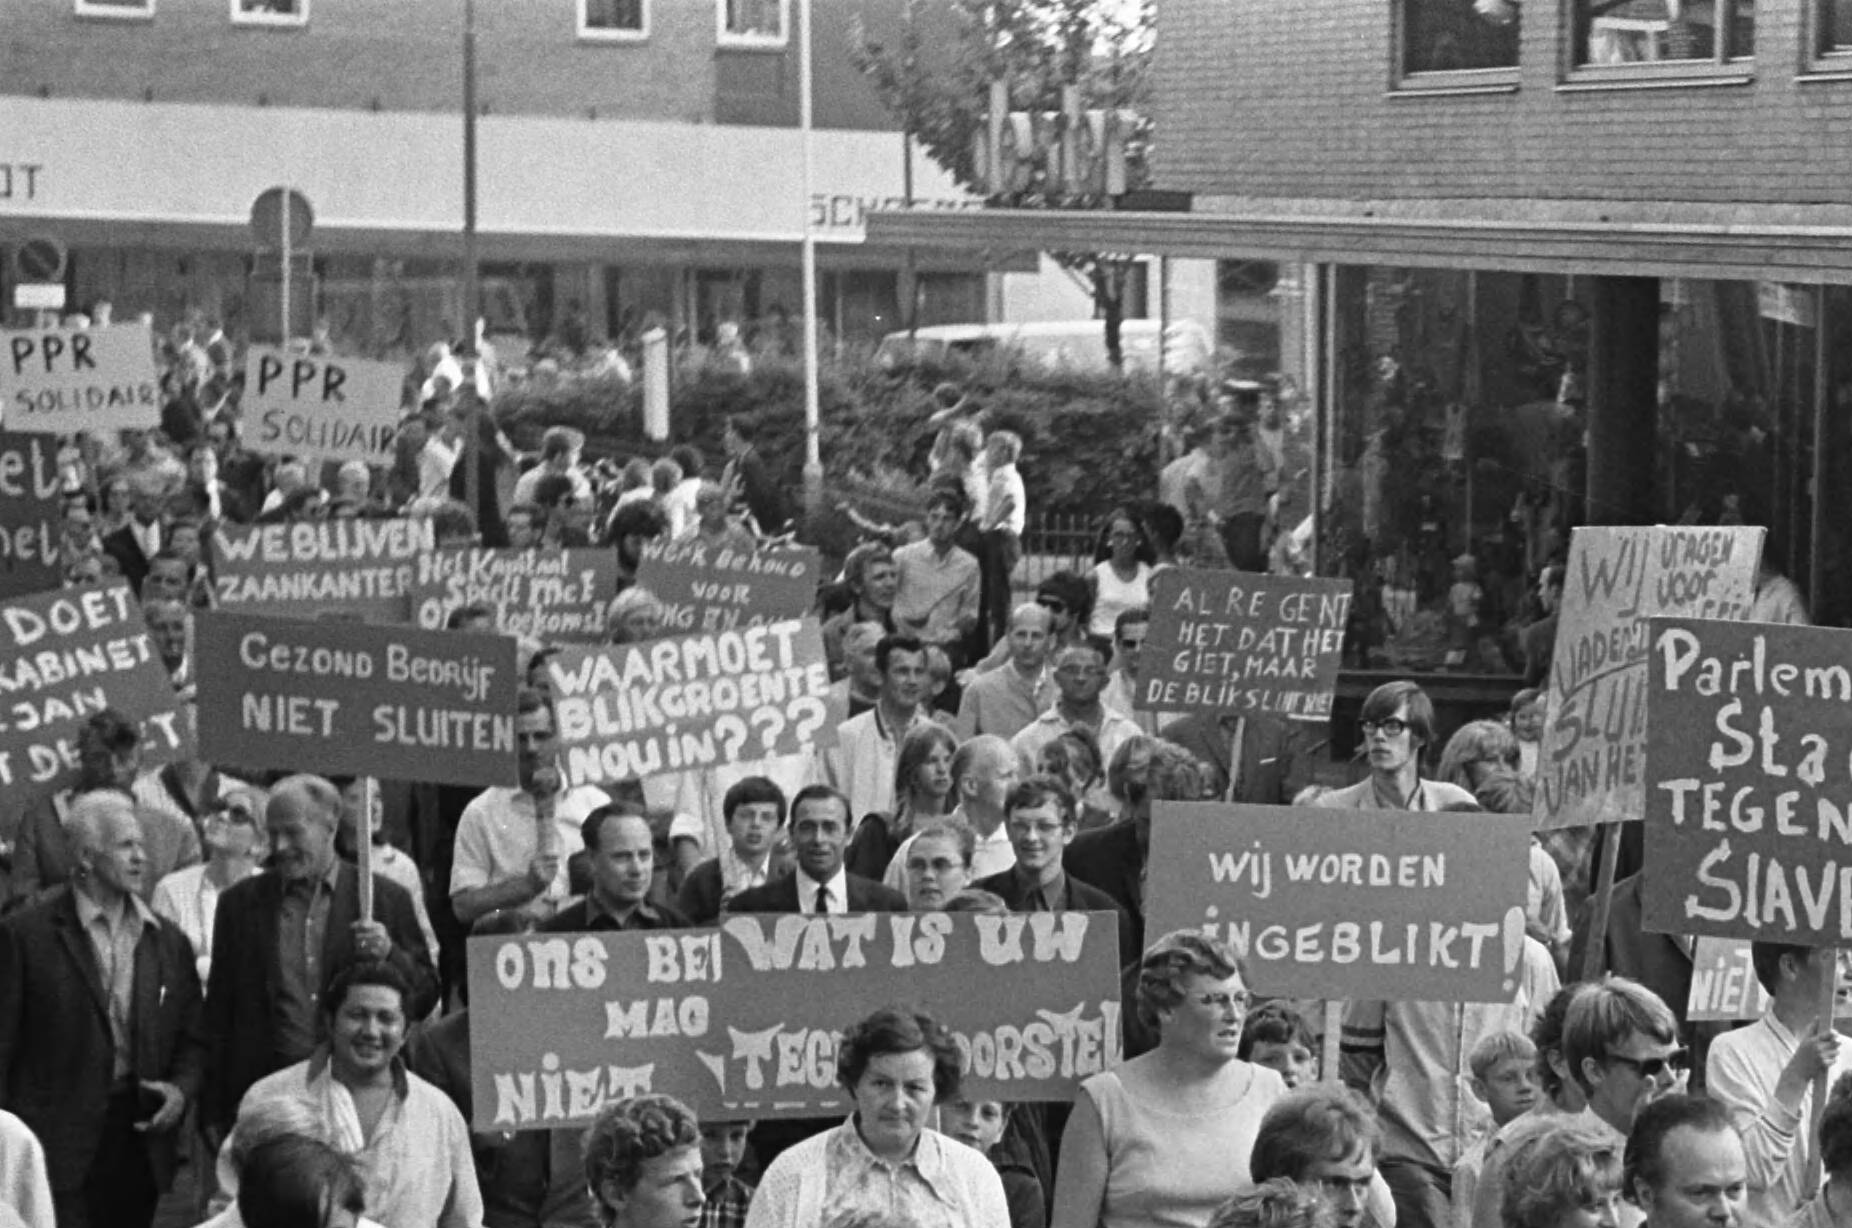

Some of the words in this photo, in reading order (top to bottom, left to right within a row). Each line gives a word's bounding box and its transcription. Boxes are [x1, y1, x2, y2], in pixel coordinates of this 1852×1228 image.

[11, 333, 96, 374] PPR
[15, 383, 156, 413] SOLIDAIR
[260, 354, 347, 401] PPR
[262, 410, 399, 453] SOLIDAIR
[3, 585, 130, 646] DOET
[1177, 620, 1233, 648] HET
[1238, 626, 1298, 659] DAT
[1302, 627, 1345, 657] HET
[1243, 655, 1316, 679] MAAR
[241, 691, 340, 738] NIET
[372, 703, 515, 753] SLUITEN
[1708, 697, 1830, 789] Sta
[1284, 852, 1446, 889] WORDEN
[721, 912, 878, 972] WAT
[890, 911, 954, 968] IS
[973, 912, 1090, 967] UW
